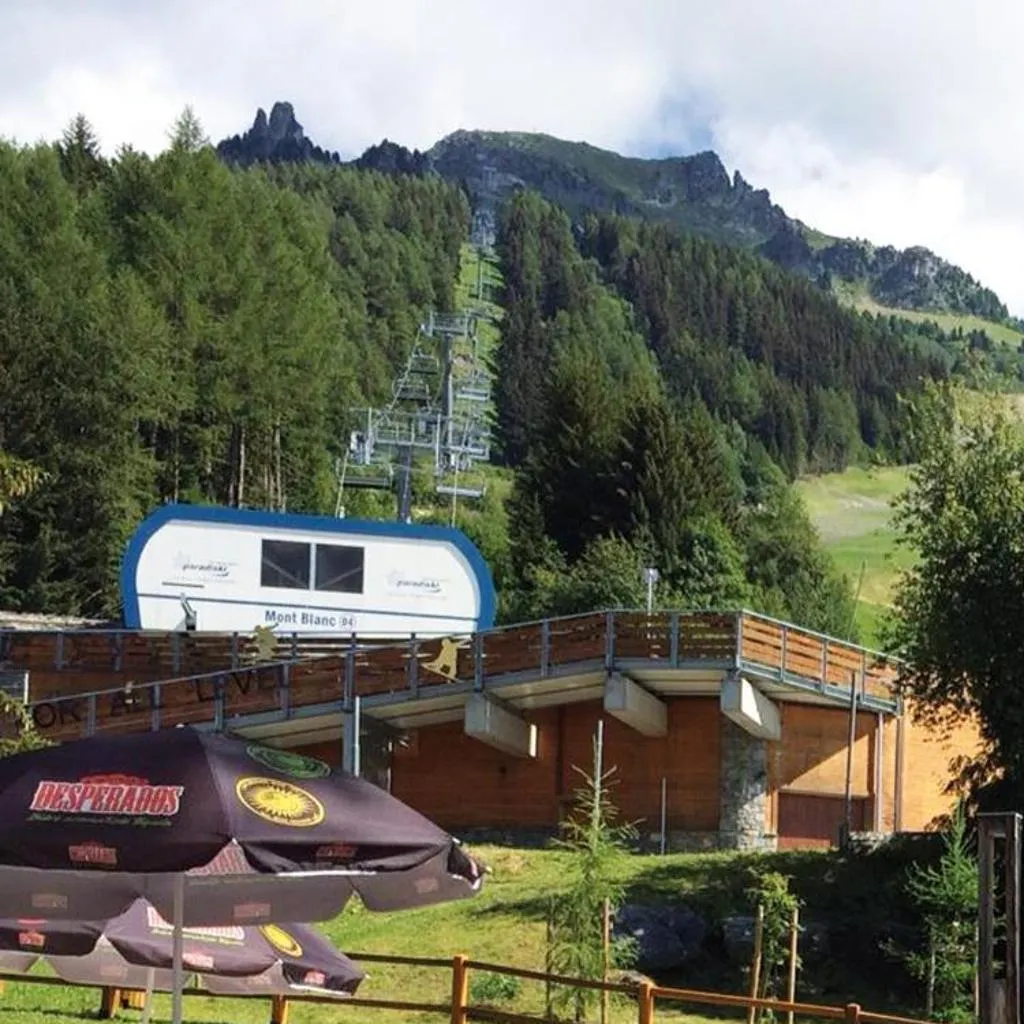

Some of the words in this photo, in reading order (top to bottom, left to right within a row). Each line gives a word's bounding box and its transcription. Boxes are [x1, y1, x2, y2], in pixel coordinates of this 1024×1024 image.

[263, 610, 297, 624] Mont
[300, 611, 337, 627] Blanc
[29, 780, 184, 816] DESPERADOS
